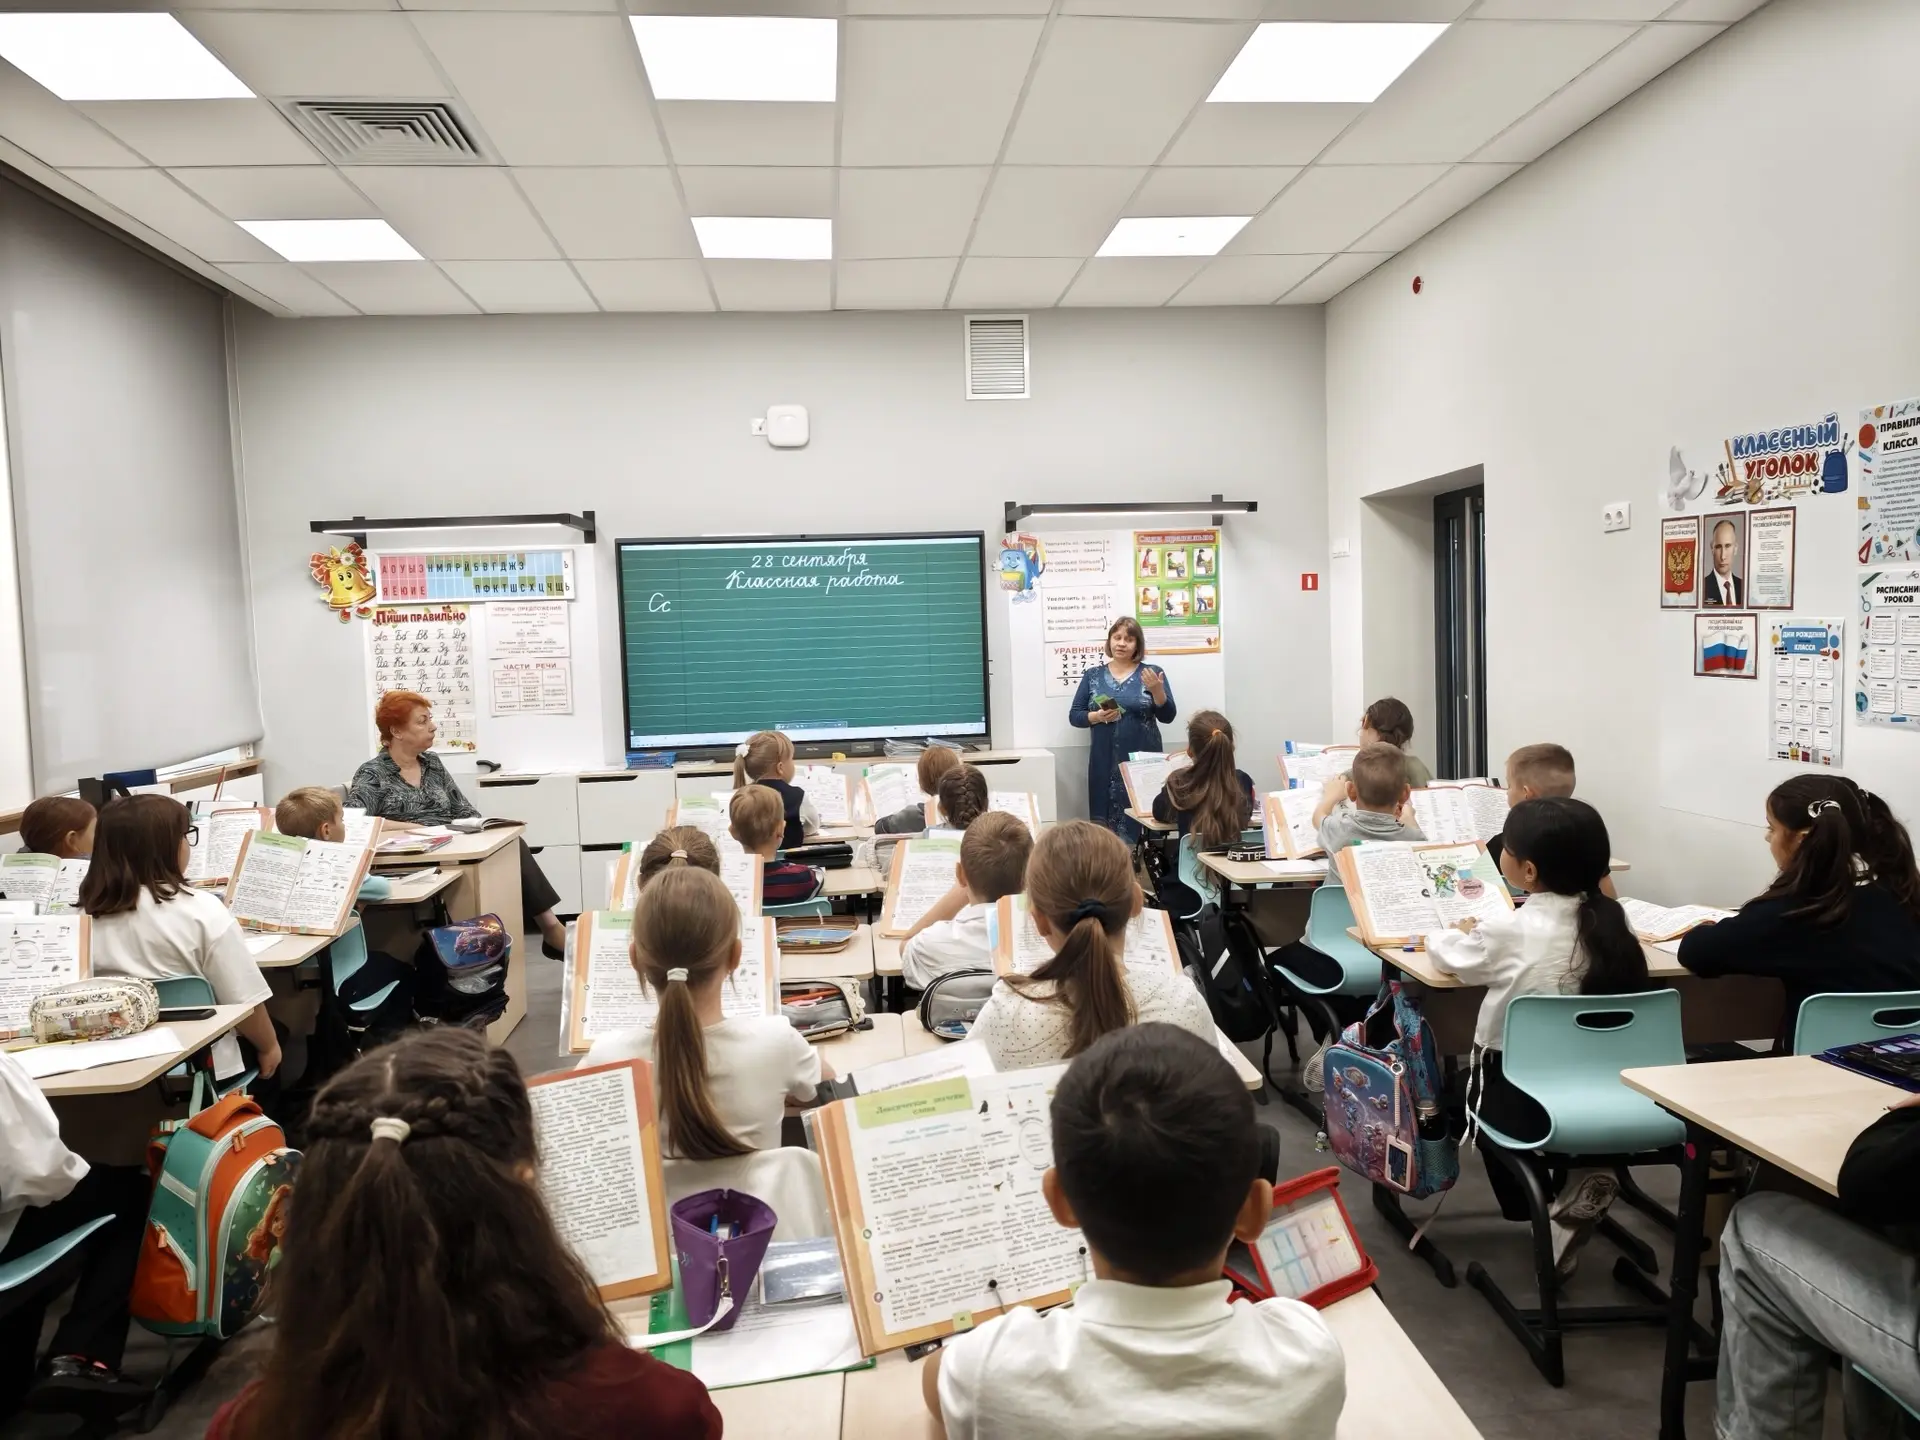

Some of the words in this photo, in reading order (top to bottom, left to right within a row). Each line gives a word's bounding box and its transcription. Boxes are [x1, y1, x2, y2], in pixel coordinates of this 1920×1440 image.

[1733, 413, 1839, 456] КЛАССНЫЙ
[1880, 416, 1920, 433] ПРАВИЛА
[1883, 437, 1918, 451] КЛАССА
[1744, 452, 1818, 479] УГОЛОК
[751, 555, 773, 569] 28
[782, 548, 868, 572] сентября
[725, 569, 820, 589] Классная
[826, 568, 904, 594] работа
[1876, 585, 1920, 594] РАСПИСАНИ
[648, 593, 671, 612] Сс
